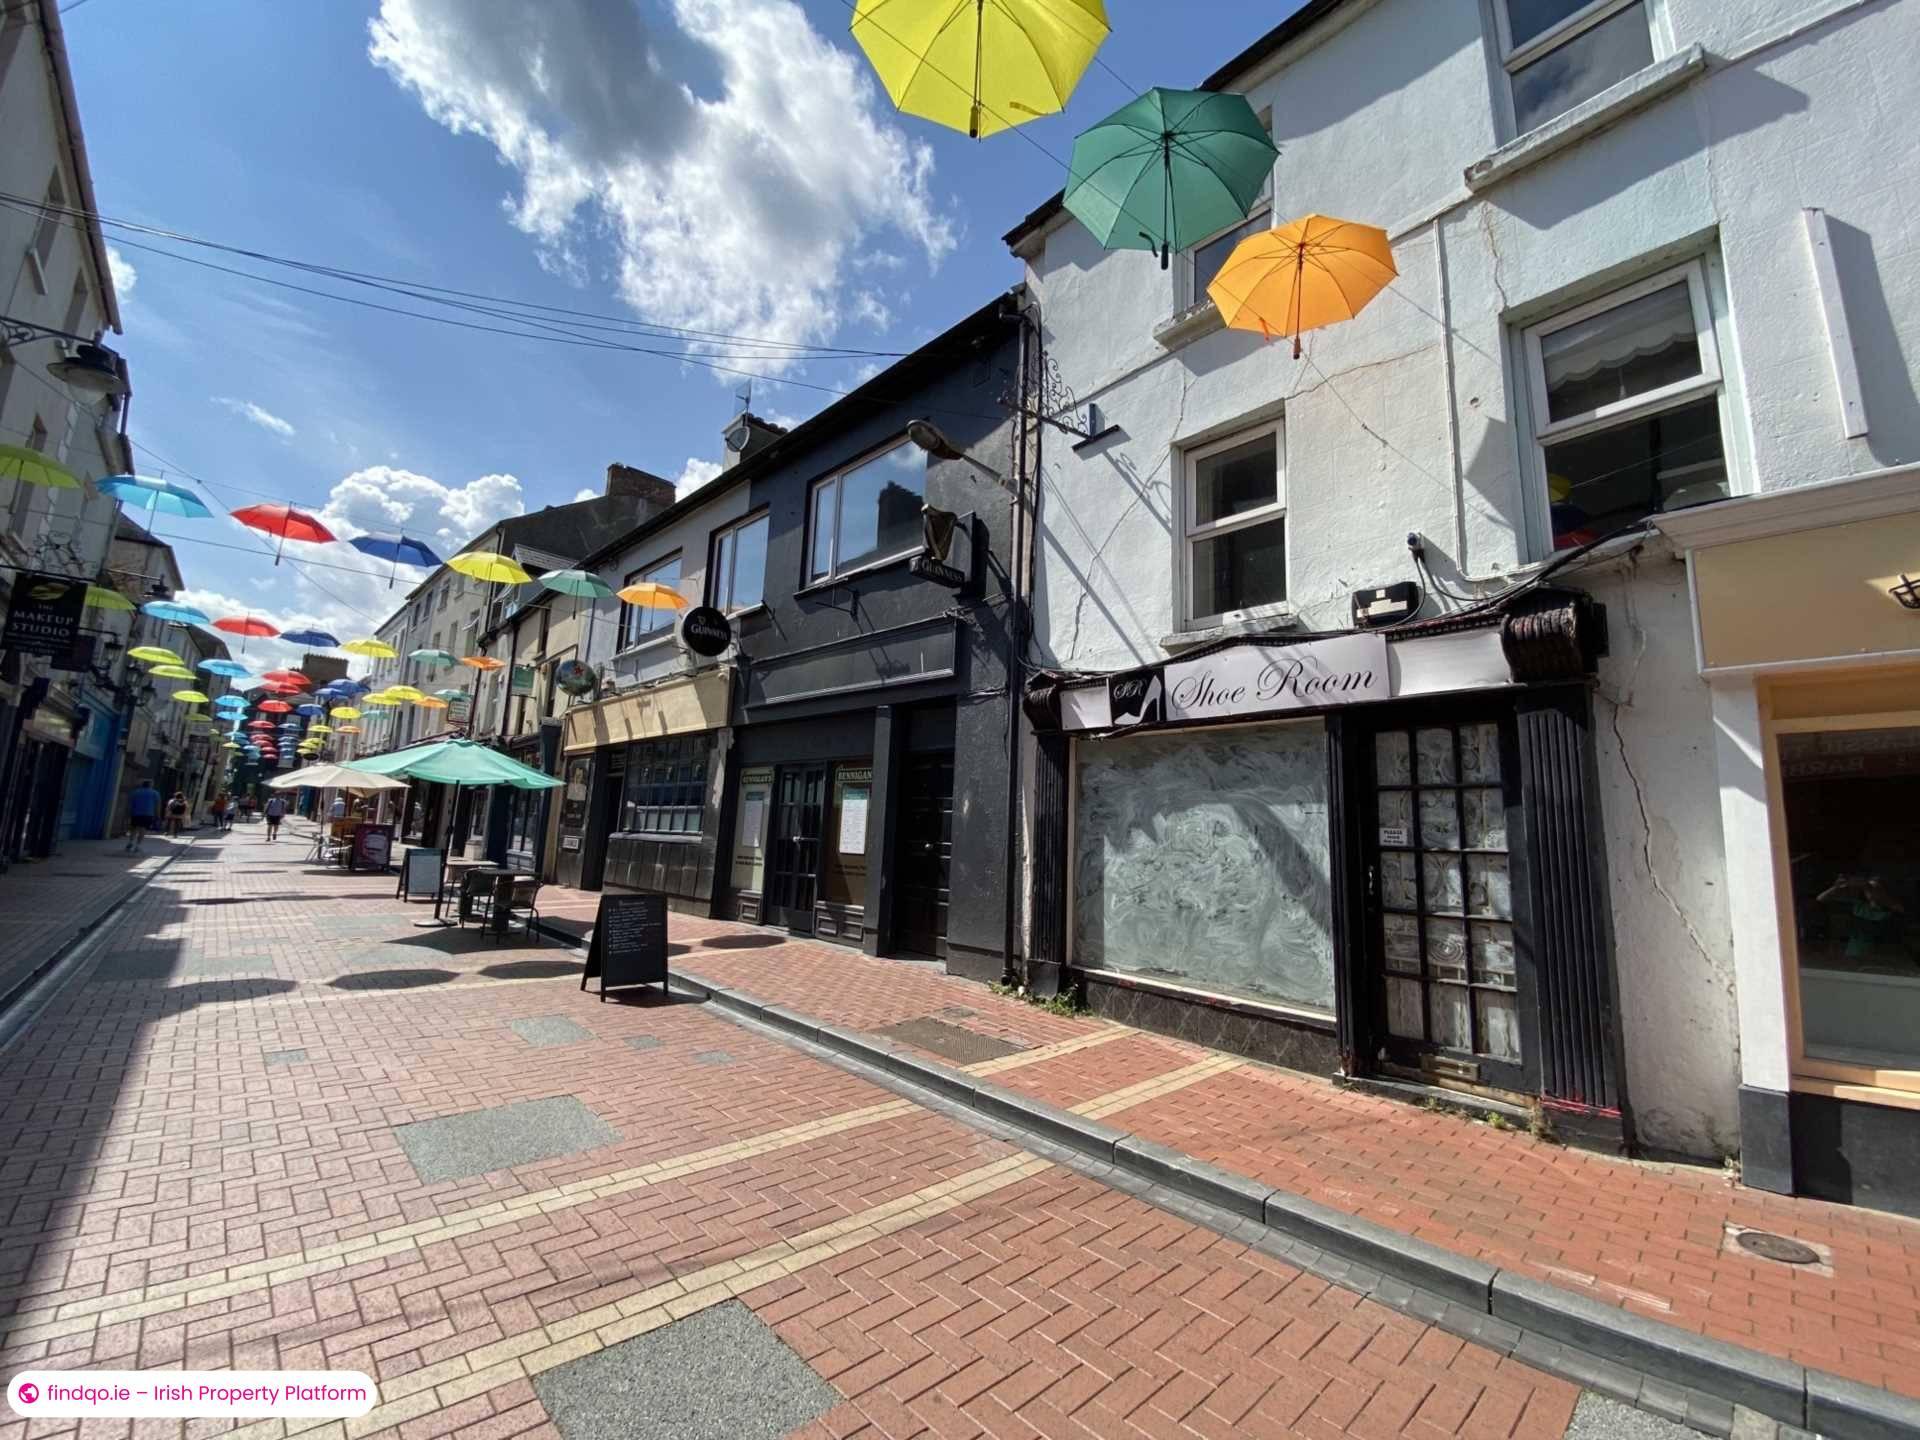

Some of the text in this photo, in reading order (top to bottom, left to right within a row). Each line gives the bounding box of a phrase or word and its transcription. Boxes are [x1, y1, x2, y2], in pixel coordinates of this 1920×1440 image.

[13, 610, 73, 625] MAKEUP
[12, 622, 71, 637] STUDIO
[1172, 655, 1378, 714] Shoe Room
